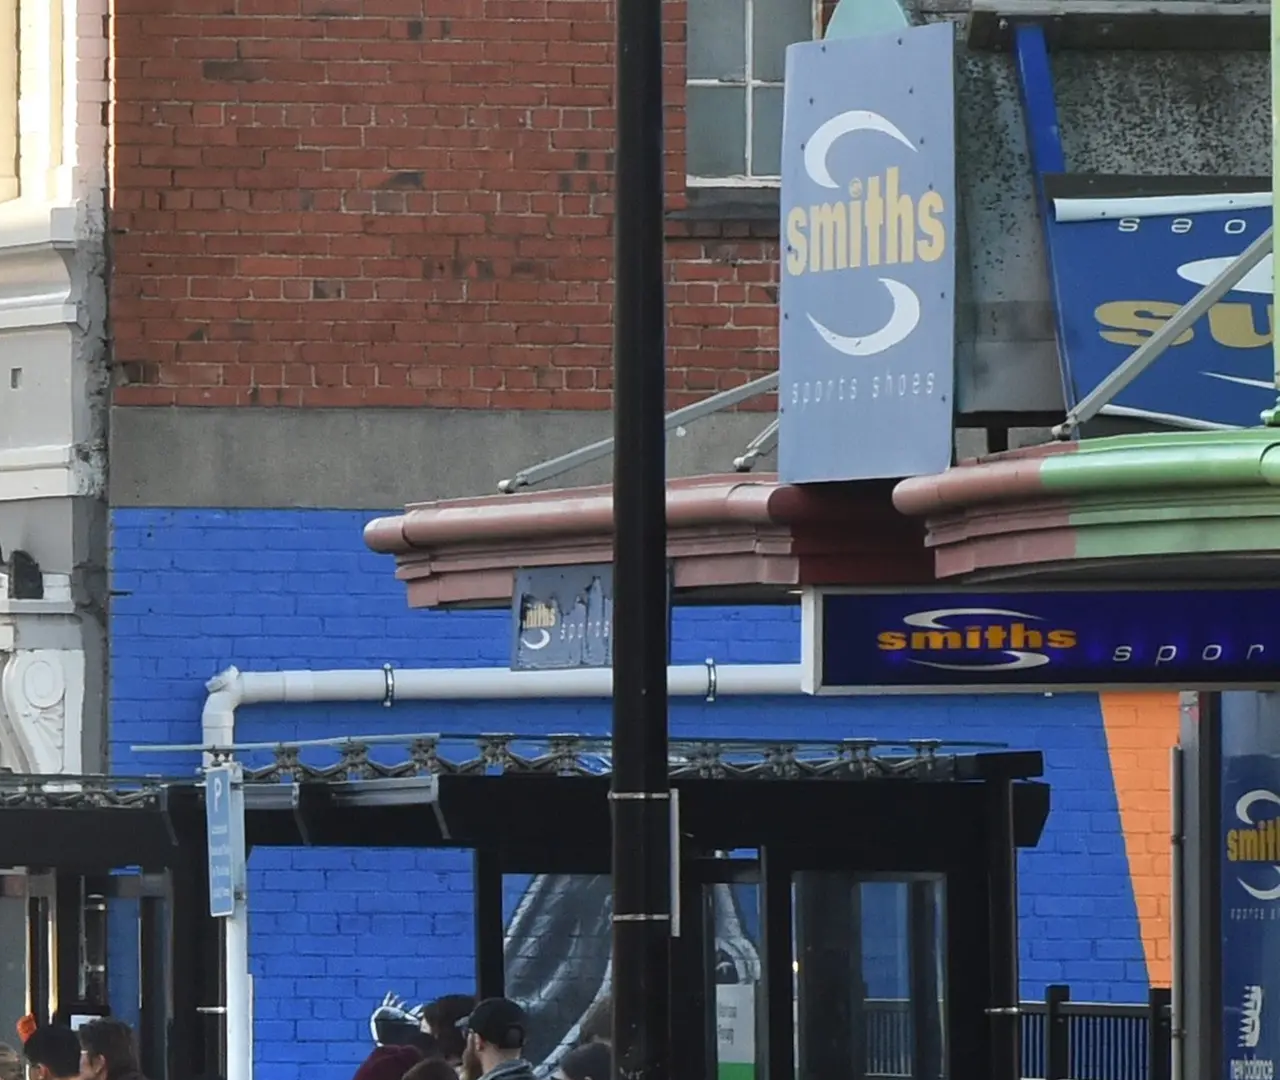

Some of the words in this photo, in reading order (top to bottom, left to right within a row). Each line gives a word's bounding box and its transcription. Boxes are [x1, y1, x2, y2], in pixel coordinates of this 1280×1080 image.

[787, 166, 946, 277] smiths
[792, 376, 858, 412] sports
[872, 370, 935, 399] shoes
[877, 623, 1077, 651] smiths
[1113, 642, 1265, 665] spor
[213, 777, 222, 812] P
